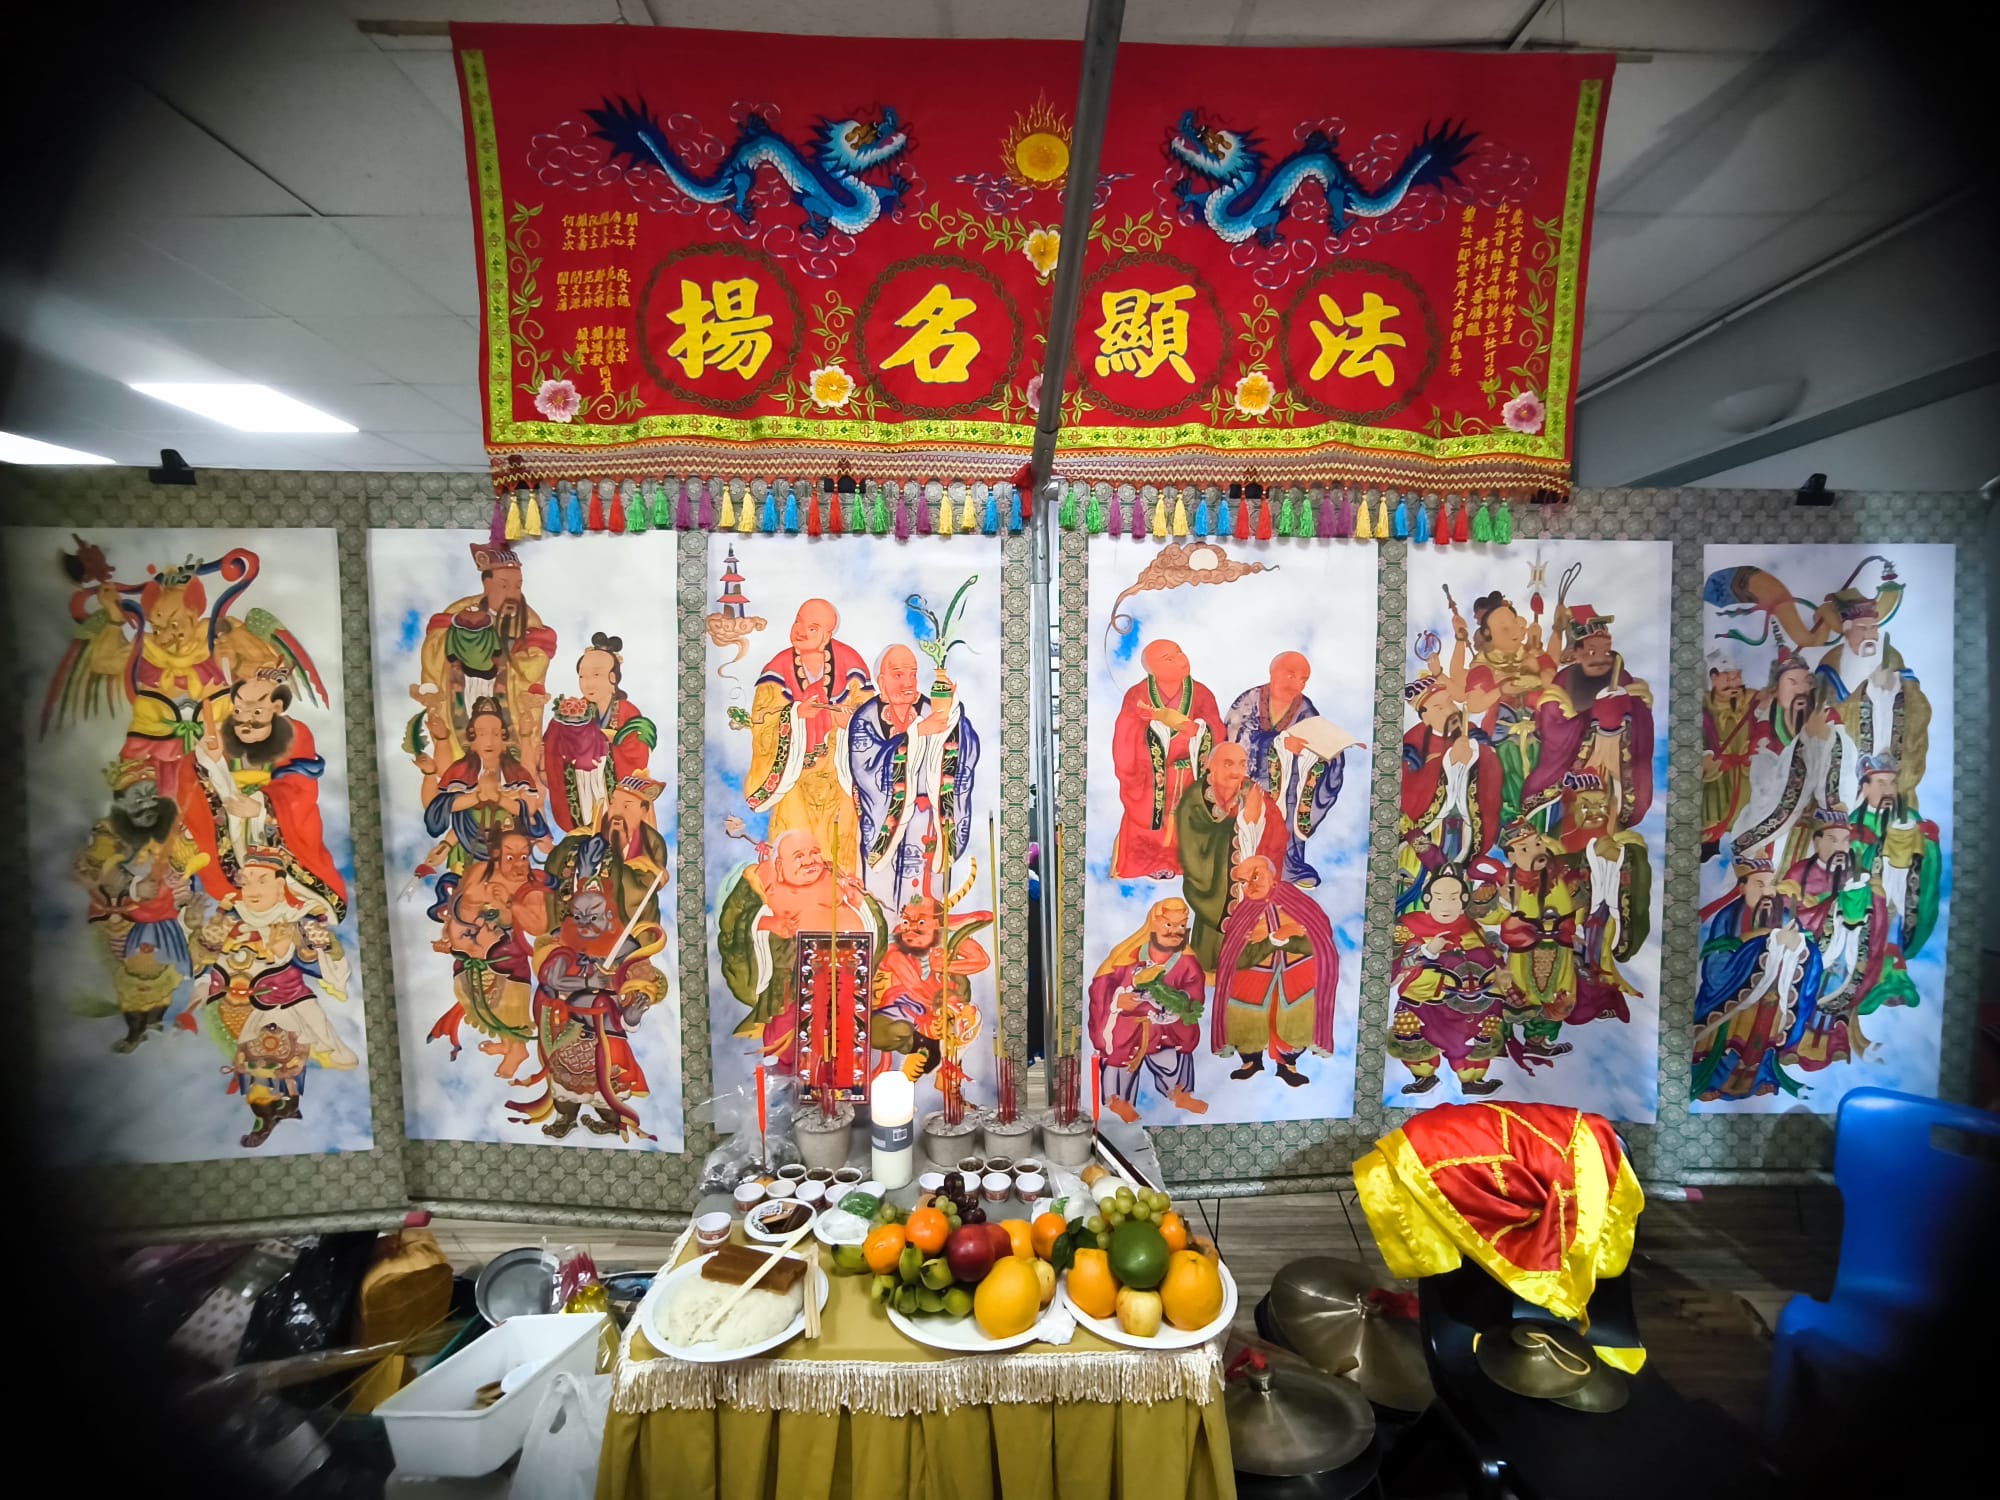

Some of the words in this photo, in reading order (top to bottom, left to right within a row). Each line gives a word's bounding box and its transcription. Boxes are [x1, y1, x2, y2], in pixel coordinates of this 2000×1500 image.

[666, 278, 773, 380] 揚
[880, 283, 981, 384] 名
[1094, 284, 1196, 385] 顯
[1308, 292, 1406, 387] 法
